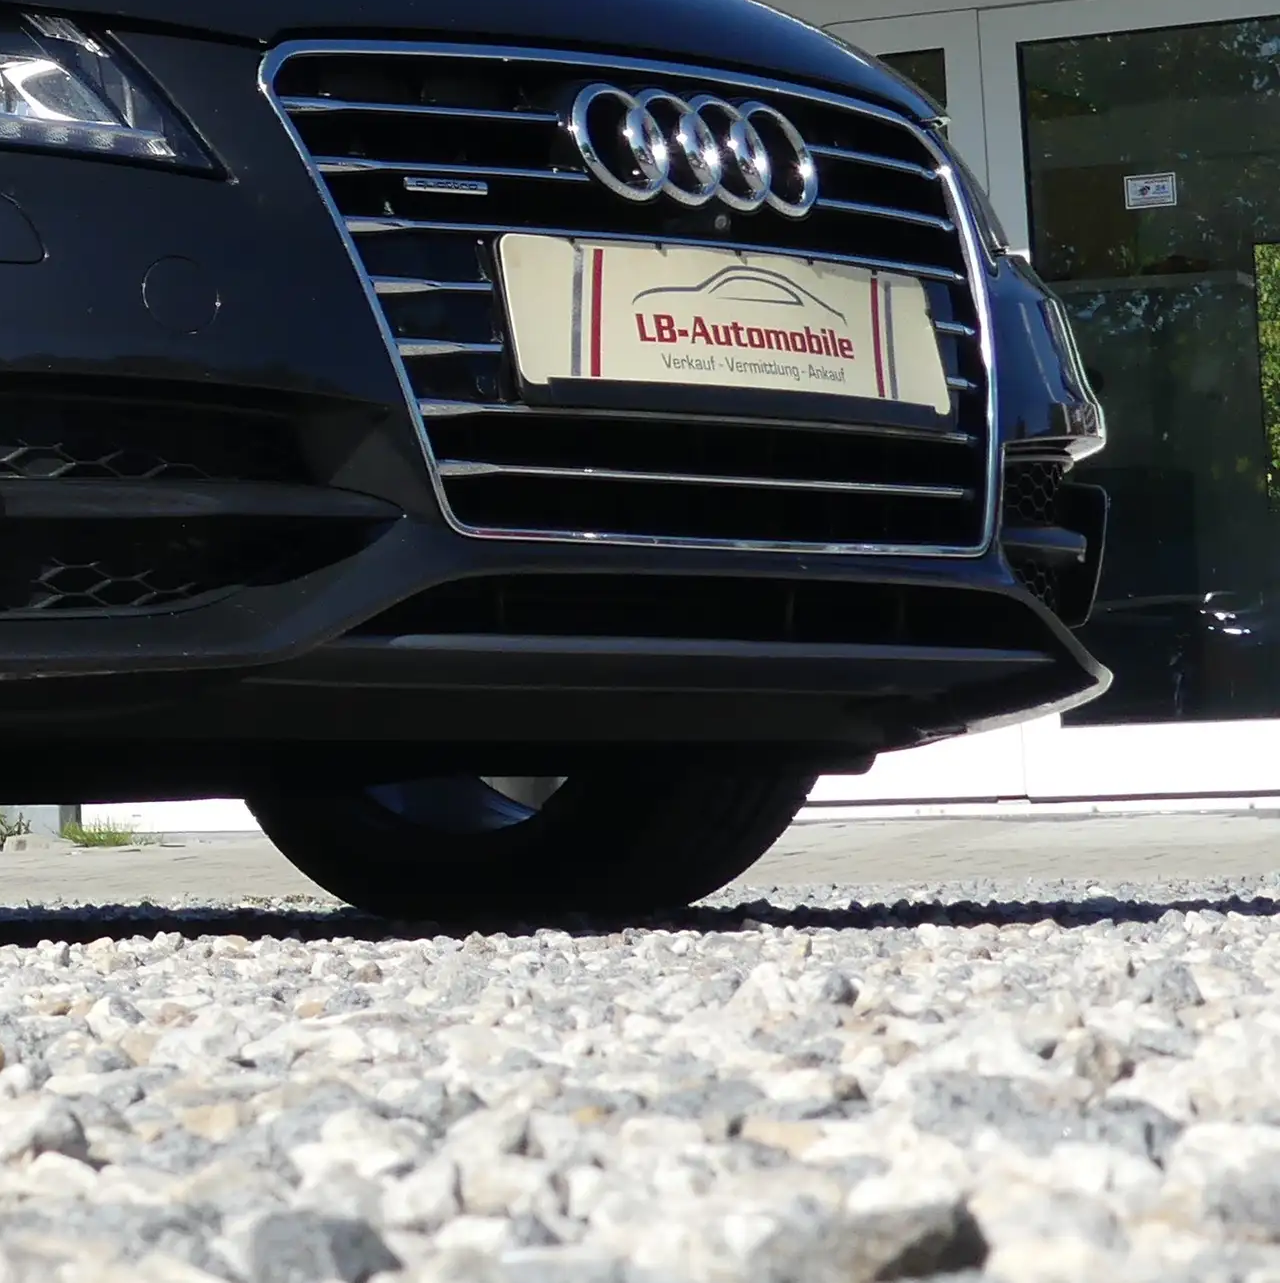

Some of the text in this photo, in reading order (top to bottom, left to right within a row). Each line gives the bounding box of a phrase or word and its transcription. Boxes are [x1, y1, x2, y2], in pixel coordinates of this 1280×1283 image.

[635, 313, 855, 360] LB-Automobile
[661, 352, 716, 371] Verkauf
[724, 356, 800, 381] Vermittlung
[807, 363, 846, 383] Ankauf
